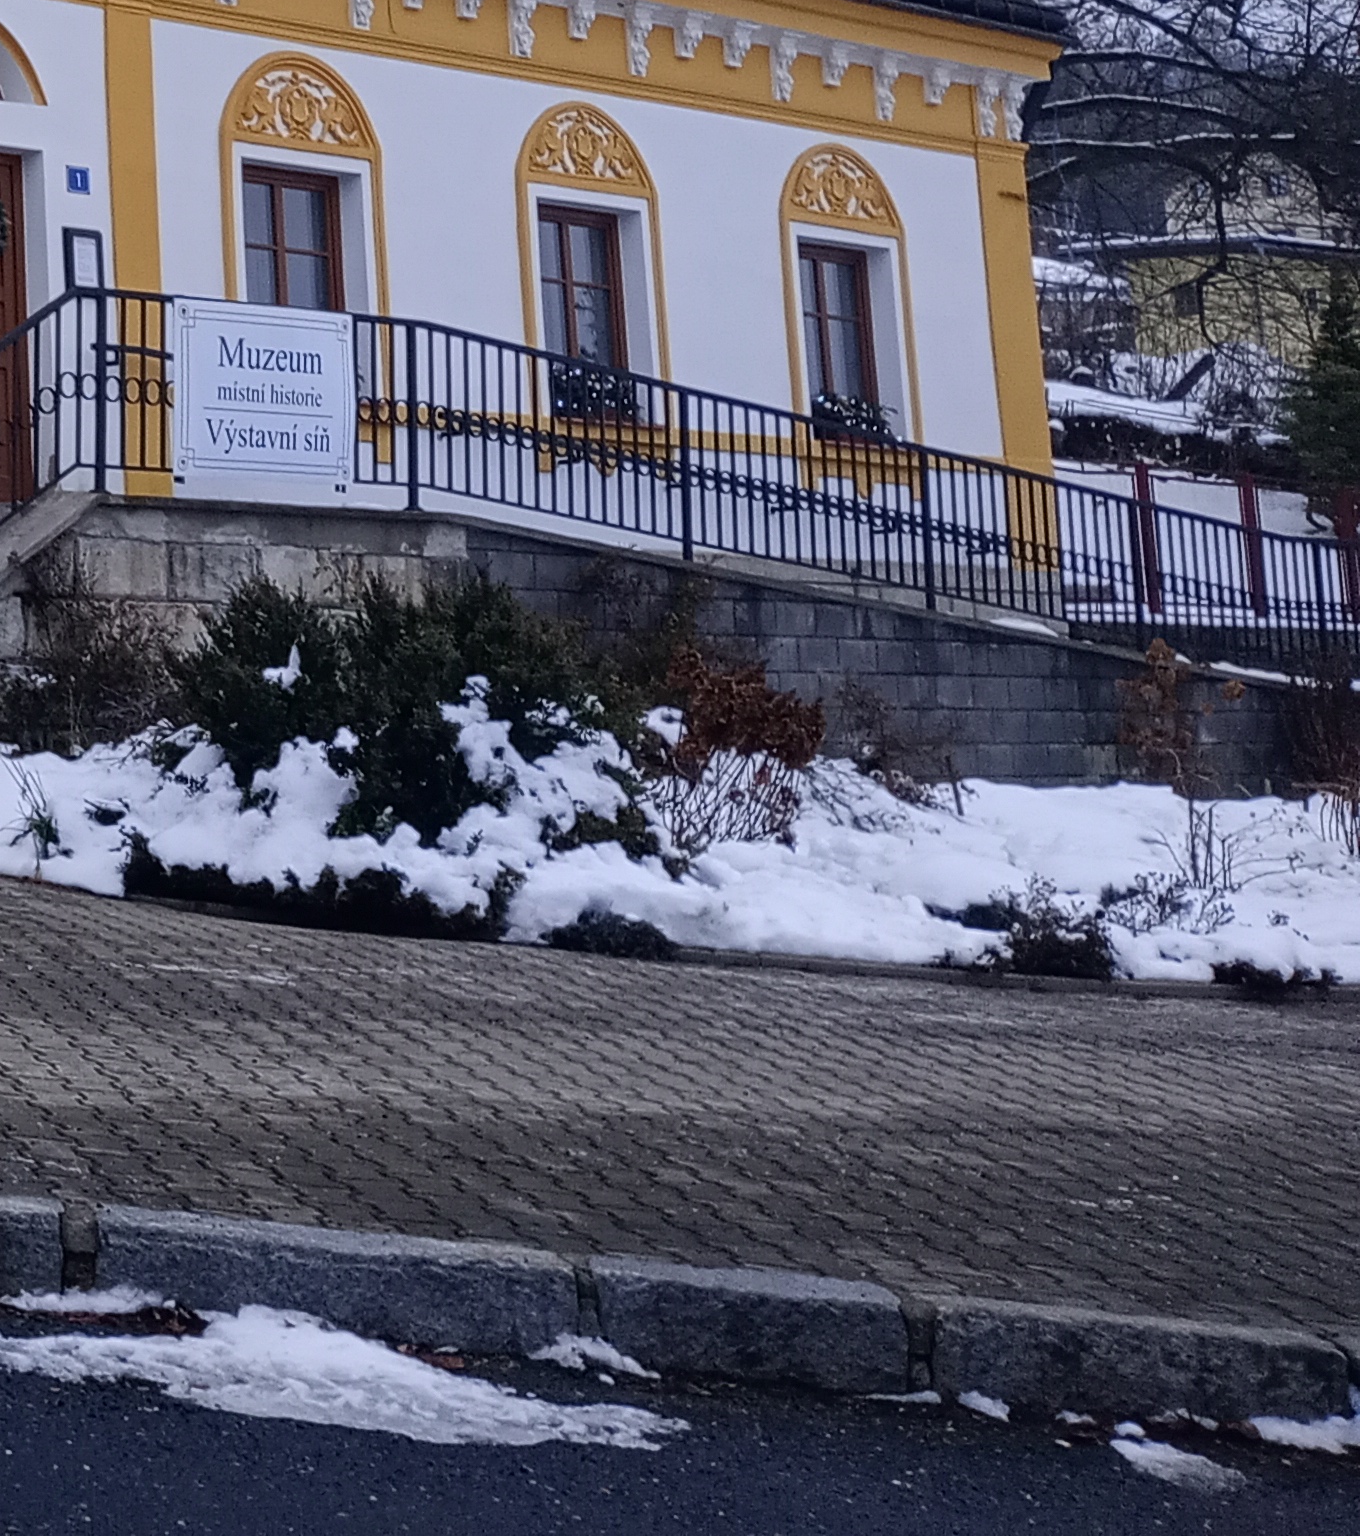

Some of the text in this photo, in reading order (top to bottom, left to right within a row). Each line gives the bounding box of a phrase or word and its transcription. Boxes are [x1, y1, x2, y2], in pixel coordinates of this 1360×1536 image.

[76, 172, 82, 188] 1
[217, 335, 323, 375] Muzeum
[217, 380, 323, 408] místní historie
[206, 417, 331, 454] Výstavní síň
